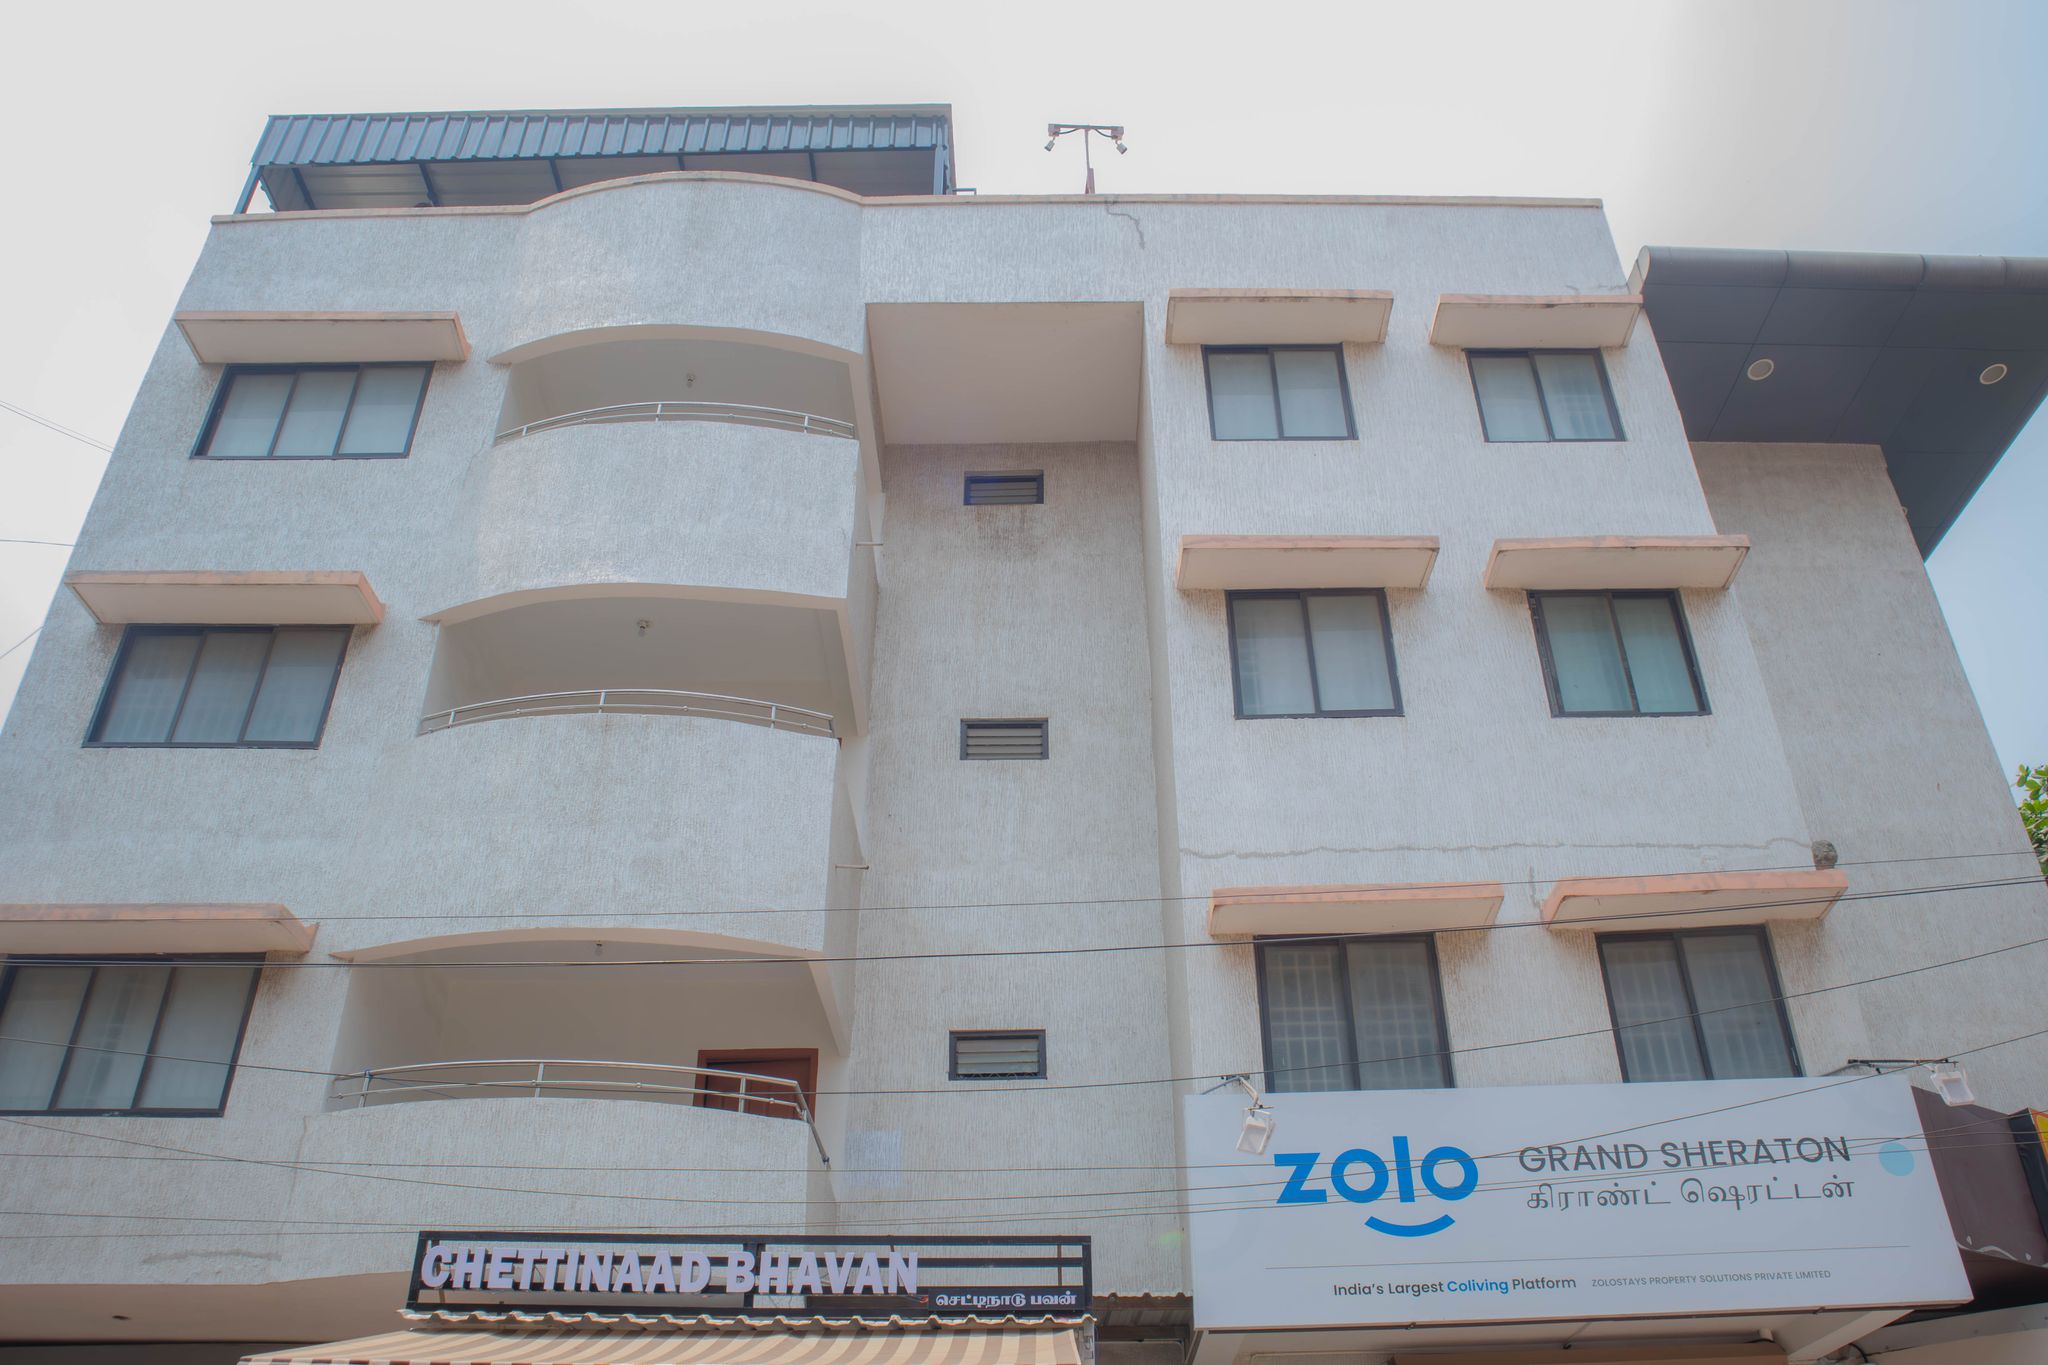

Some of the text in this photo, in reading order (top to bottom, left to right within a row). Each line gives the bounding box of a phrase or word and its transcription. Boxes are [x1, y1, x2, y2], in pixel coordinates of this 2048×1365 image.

[1274, 1136, 1478, 1204] zolo
[1519, 1136, 1851, 1172] GRAND SHERATON
[1527, 1174, 1855, 1211] கிராண்ட் ஷெரட்டன்
[420, 1245, 918, 1294] CHETTINAAD BHAVAN
[1333, 1277, 1577, 1297] India’s Largest Coliving Platform
[1591, 1270, 1831, 1288] ZOLOSTAYS PROPERTY SOLUTIONS PRIVATE LIMITED
[935, 1290, 1077, 1308] செட்டிநாடு பவன்
